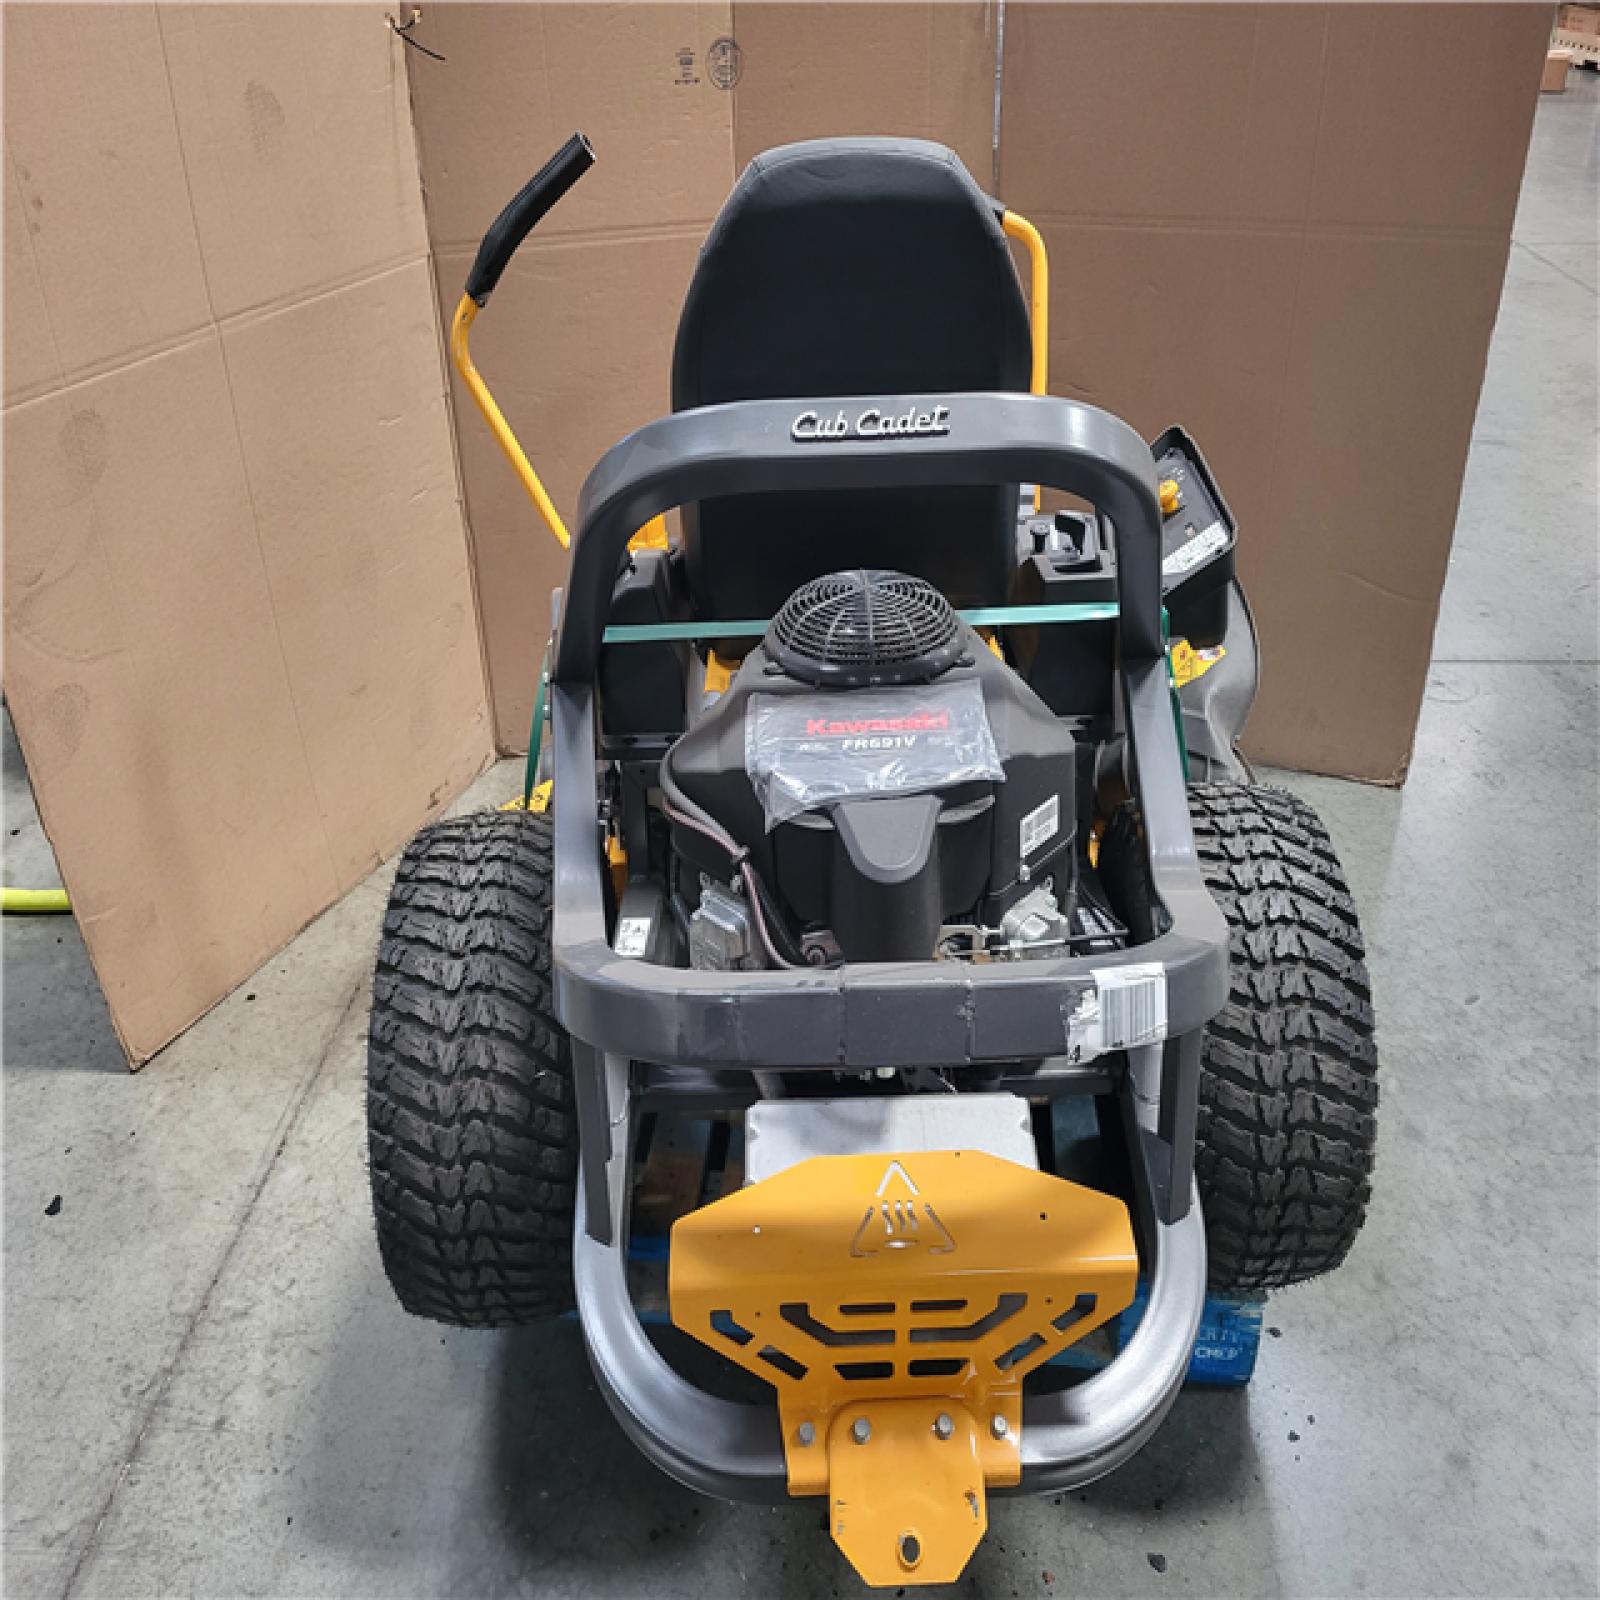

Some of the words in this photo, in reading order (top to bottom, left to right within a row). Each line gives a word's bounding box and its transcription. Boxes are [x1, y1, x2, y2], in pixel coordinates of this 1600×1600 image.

[791, 409, 849, 437] Cub
[855, 404, 950, 436] Cadet
[806, 709, 949, 736] Kawasaki
[841, 734, 917, 751] FR691V
